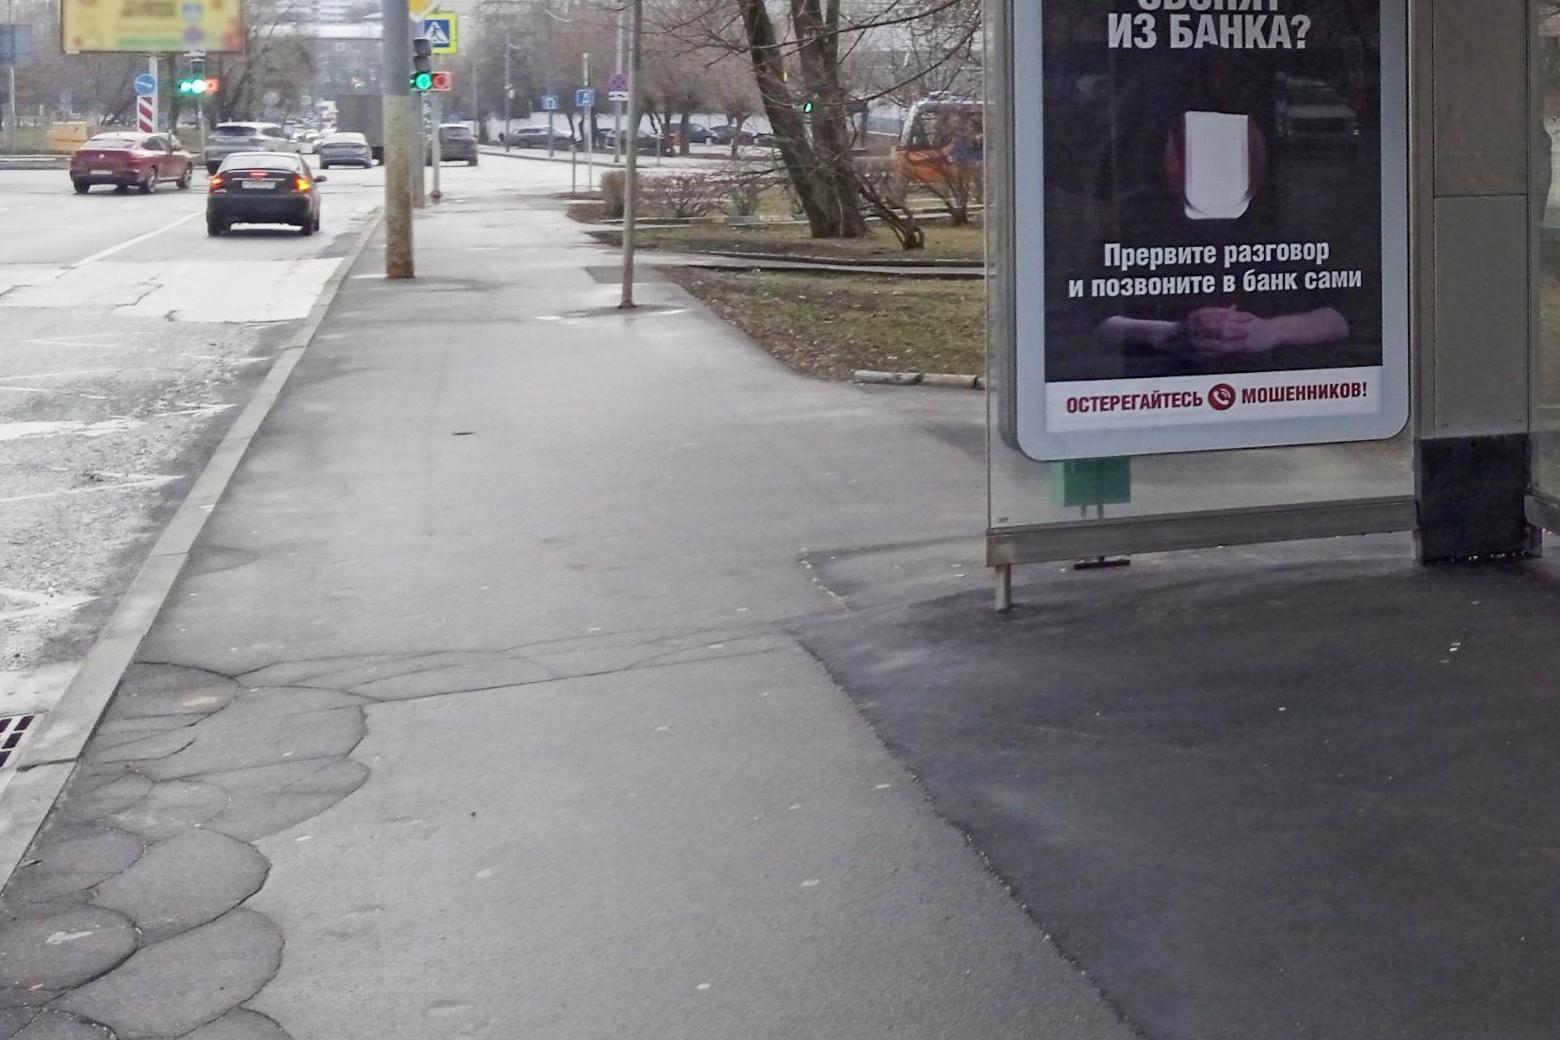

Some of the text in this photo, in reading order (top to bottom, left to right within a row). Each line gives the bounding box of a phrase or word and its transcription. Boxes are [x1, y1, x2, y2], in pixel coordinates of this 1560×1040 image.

[1108, 13, 1311, 48] ИЗ БАНКА?
[1104, 242, 1330, 272] Прервите разговор
[1068, 268, 1362, 298] и позвоните в банк сами
[1066, 381, 1368, 414] ОСТЕРЕГАЙТЕСЬ МОШЕННИКОВ!
